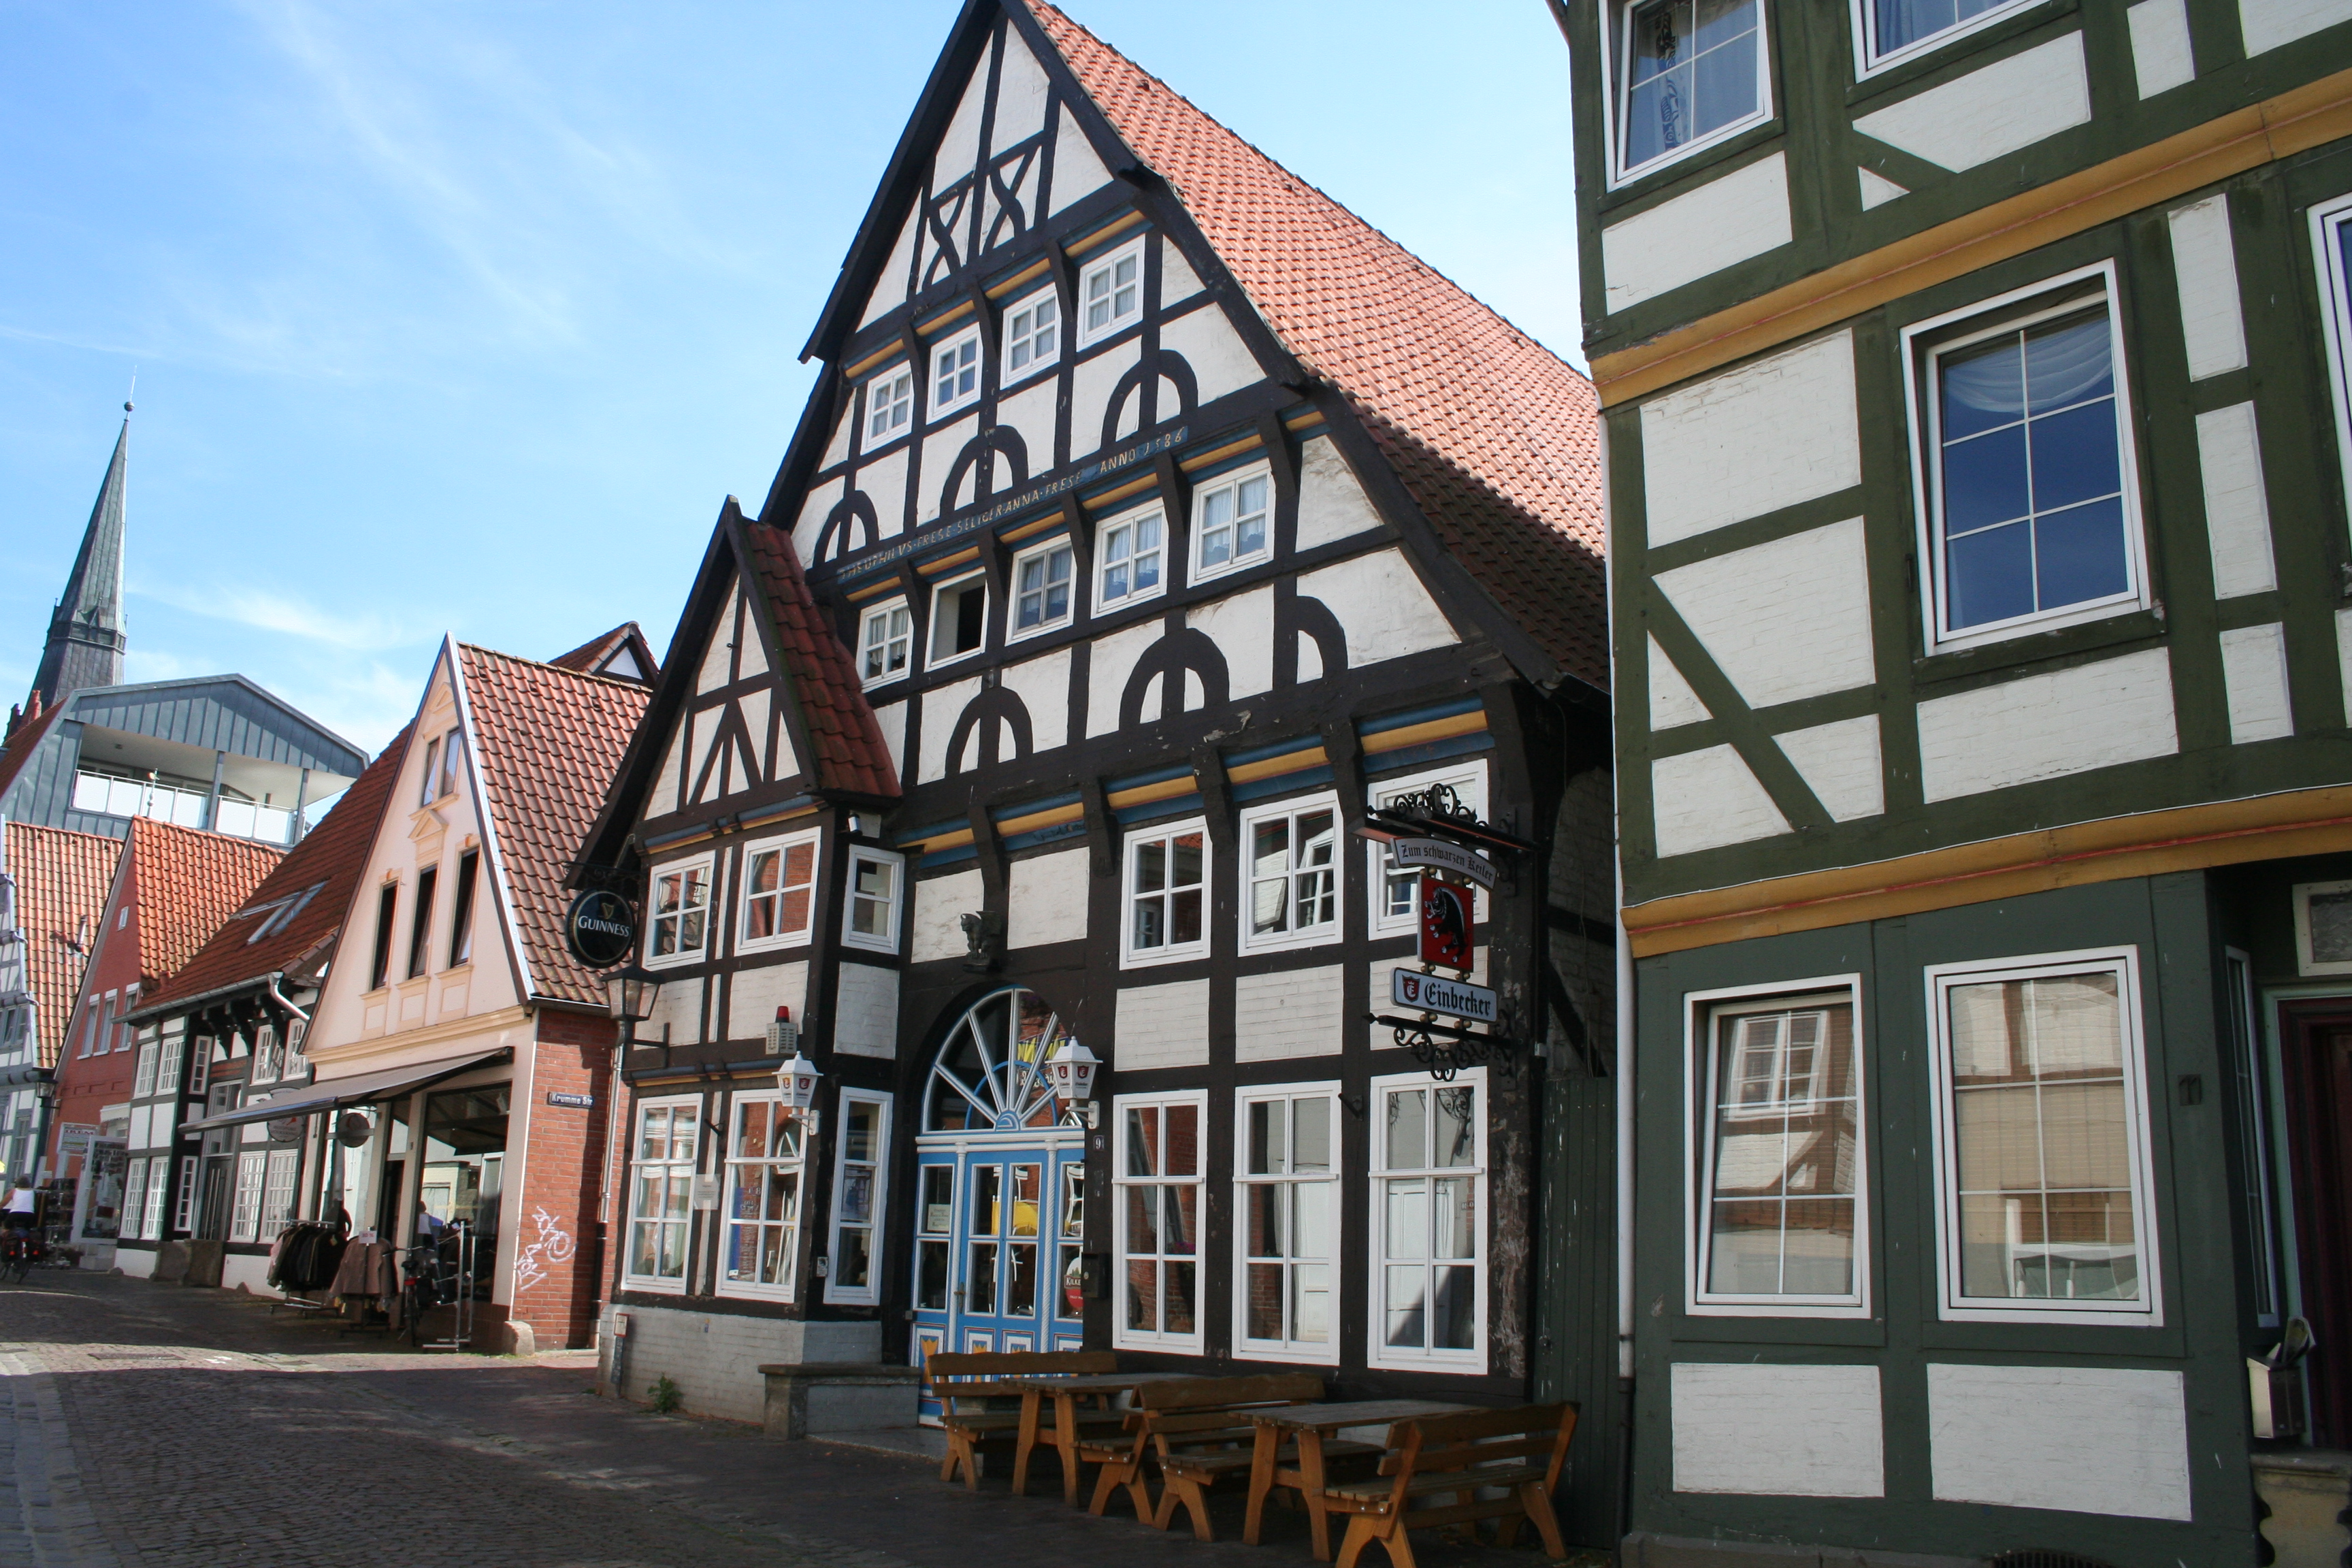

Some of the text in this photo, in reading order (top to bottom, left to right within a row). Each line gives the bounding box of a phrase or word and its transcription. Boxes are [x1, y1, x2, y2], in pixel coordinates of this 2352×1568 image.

[1100, 448, 1136, 474] ANNO
[1401, 844, 1494, 882] Zum schwarzen Keiler
[578, 915, 630, 937] GUINNESS
[1424, 982, 1491, 1017] Einbecker
[552, 1092, 581, 1105] Krumme
[1095, 1137, 1101, 1150] 9
[1066, 1277, 1081, 1286] KILKE
